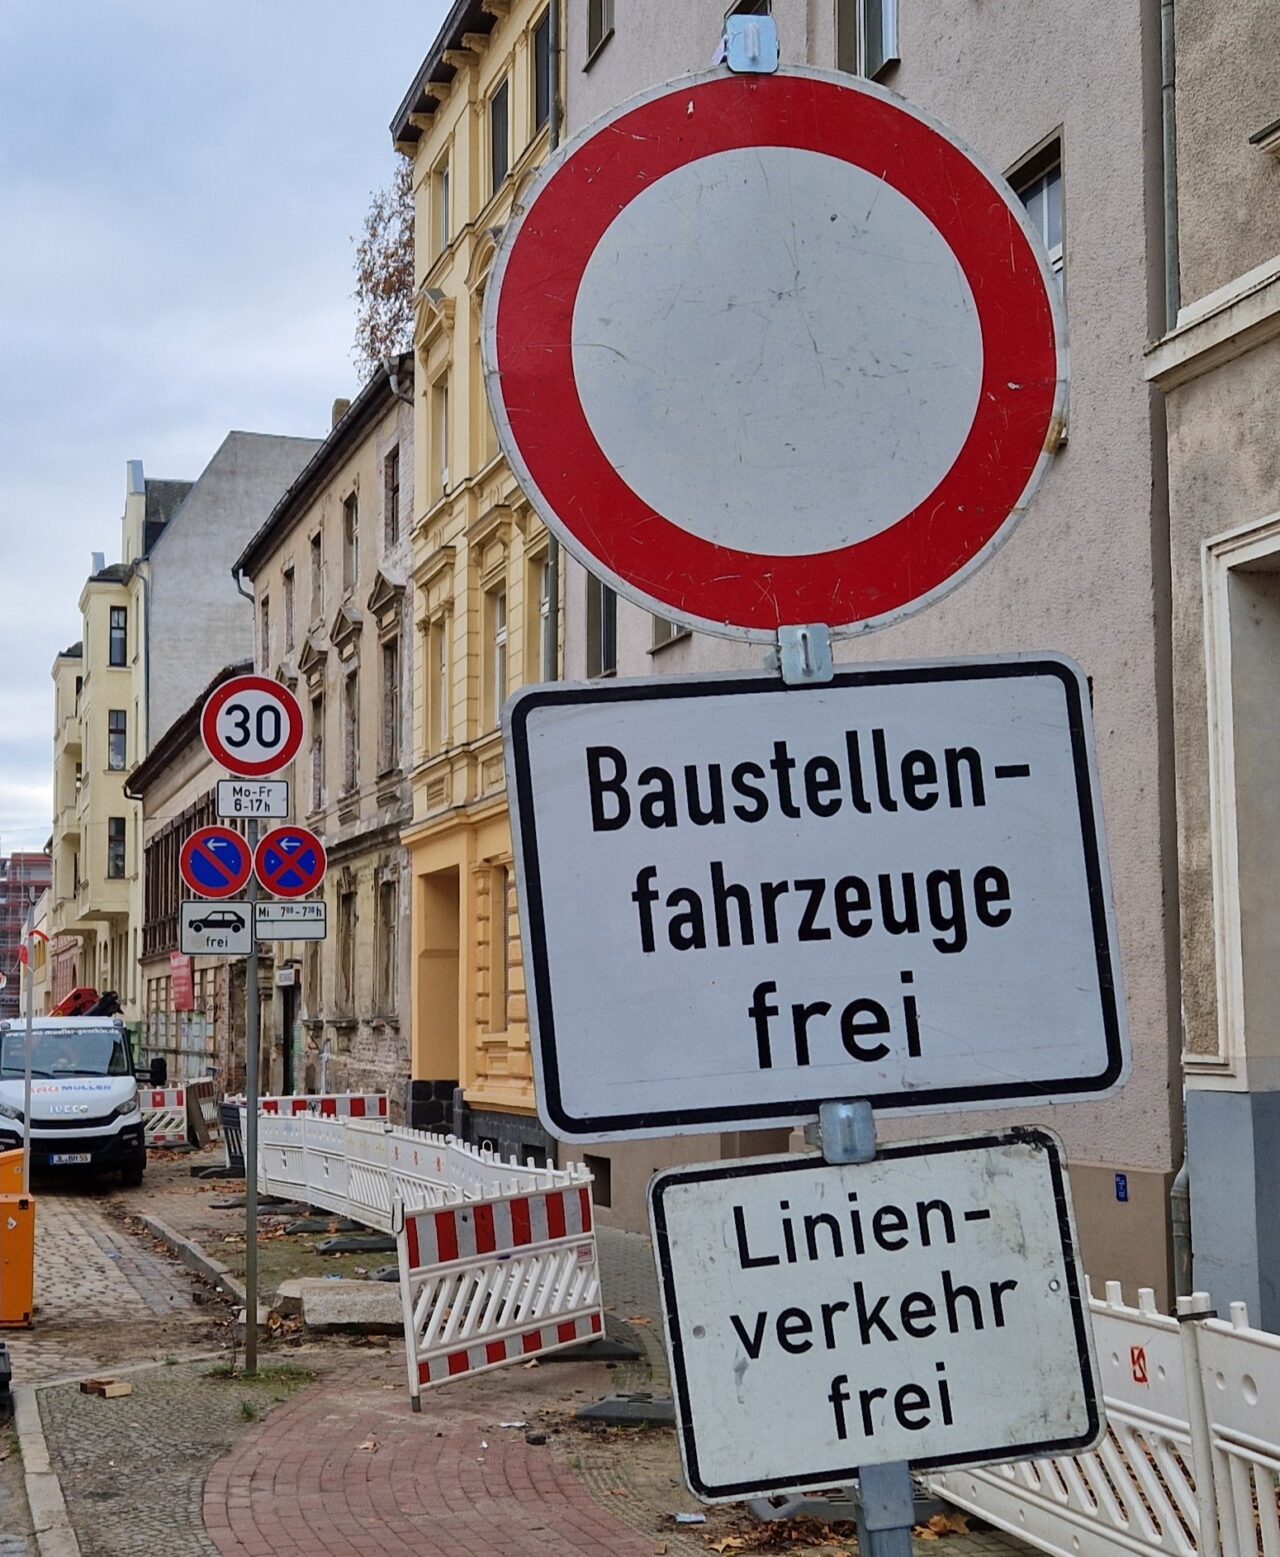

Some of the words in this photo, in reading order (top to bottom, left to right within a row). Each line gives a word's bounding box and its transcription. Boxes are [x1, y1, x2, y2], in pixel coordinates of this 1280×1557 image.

[225, 703, 282, 749] 30
[232, 785, 273, 799] Mo-Fr
[586, 728, 1032, 832] Baustellen-
[205, 936, 228, 948] frei
[258, 906, 270, 918] Mi
[631, 860, 1012, 954] fahrzeuge
[747, 970, 922, 1070] frei
[49, 1104, 89, 1114] IVECO
[733, 1191, 991, 1270] Linien-
[729, 1269, 1019, 1360] verkehr
[827, 1361, 954, 1440] frei
